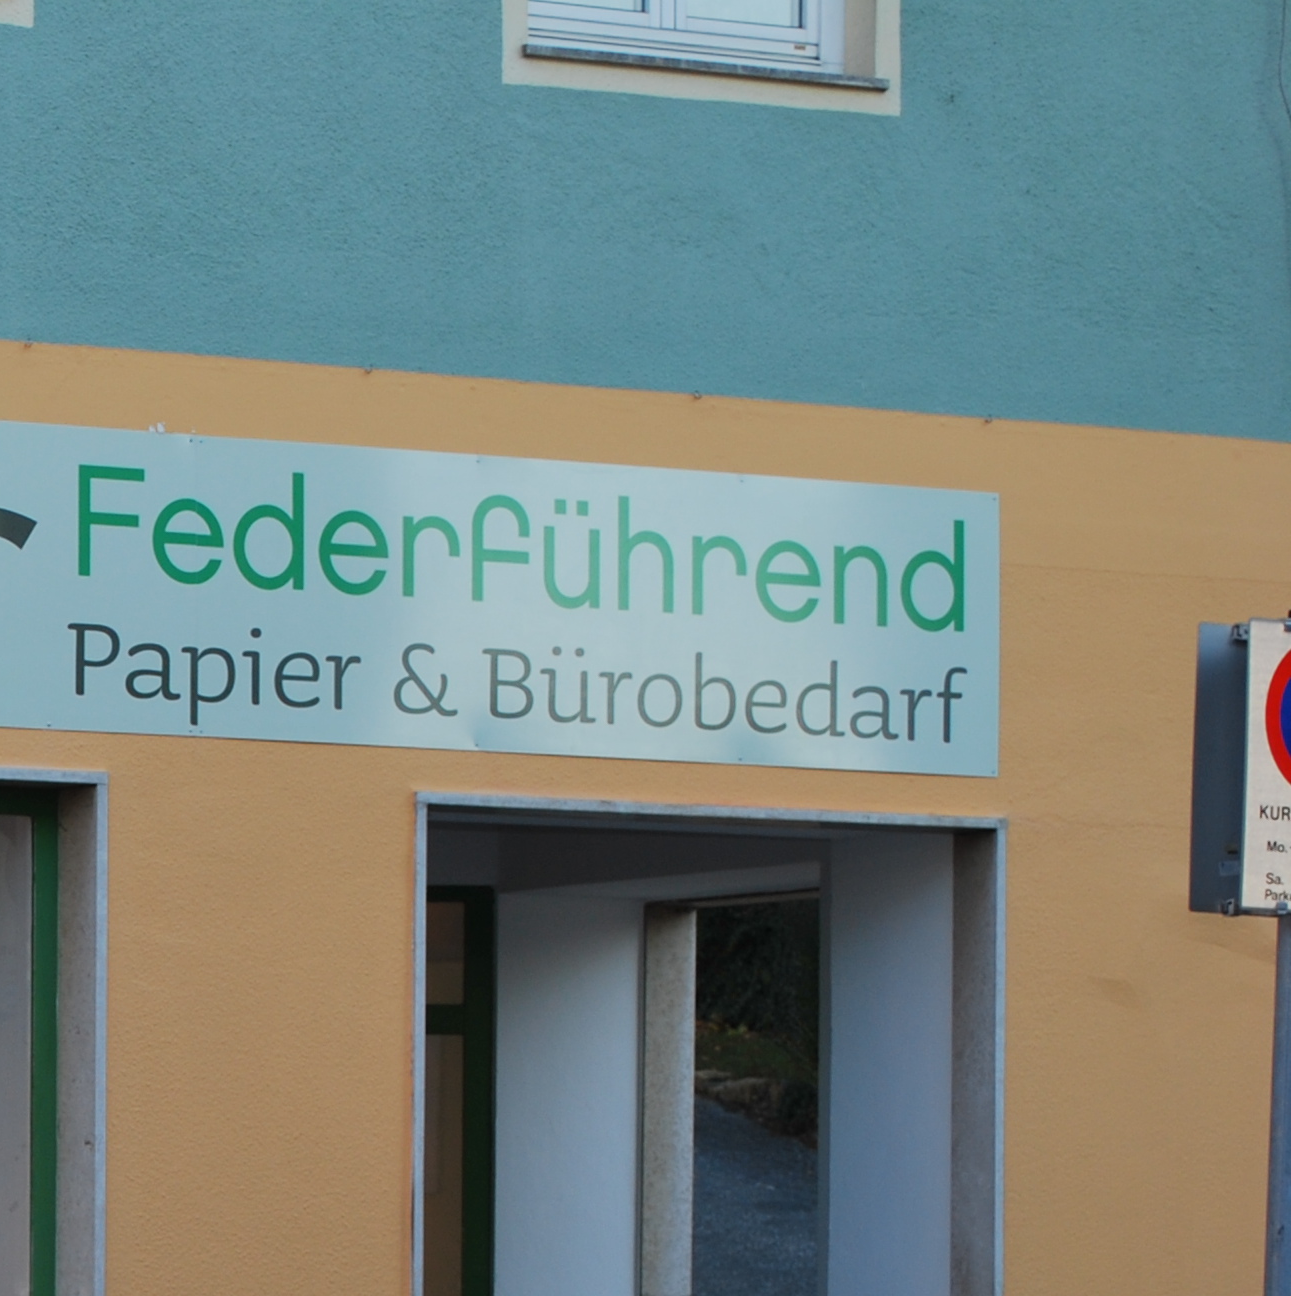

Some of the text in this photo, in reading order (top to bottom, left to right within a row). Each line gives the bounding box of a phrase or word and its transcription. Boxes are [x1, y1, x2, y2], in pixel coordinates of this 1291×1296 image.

[77, 464, 966, 633] Federführend
[67, 622, 968, 745] Papier & Bürobedarf
[1266, 872, 1284, 885] Sa.
